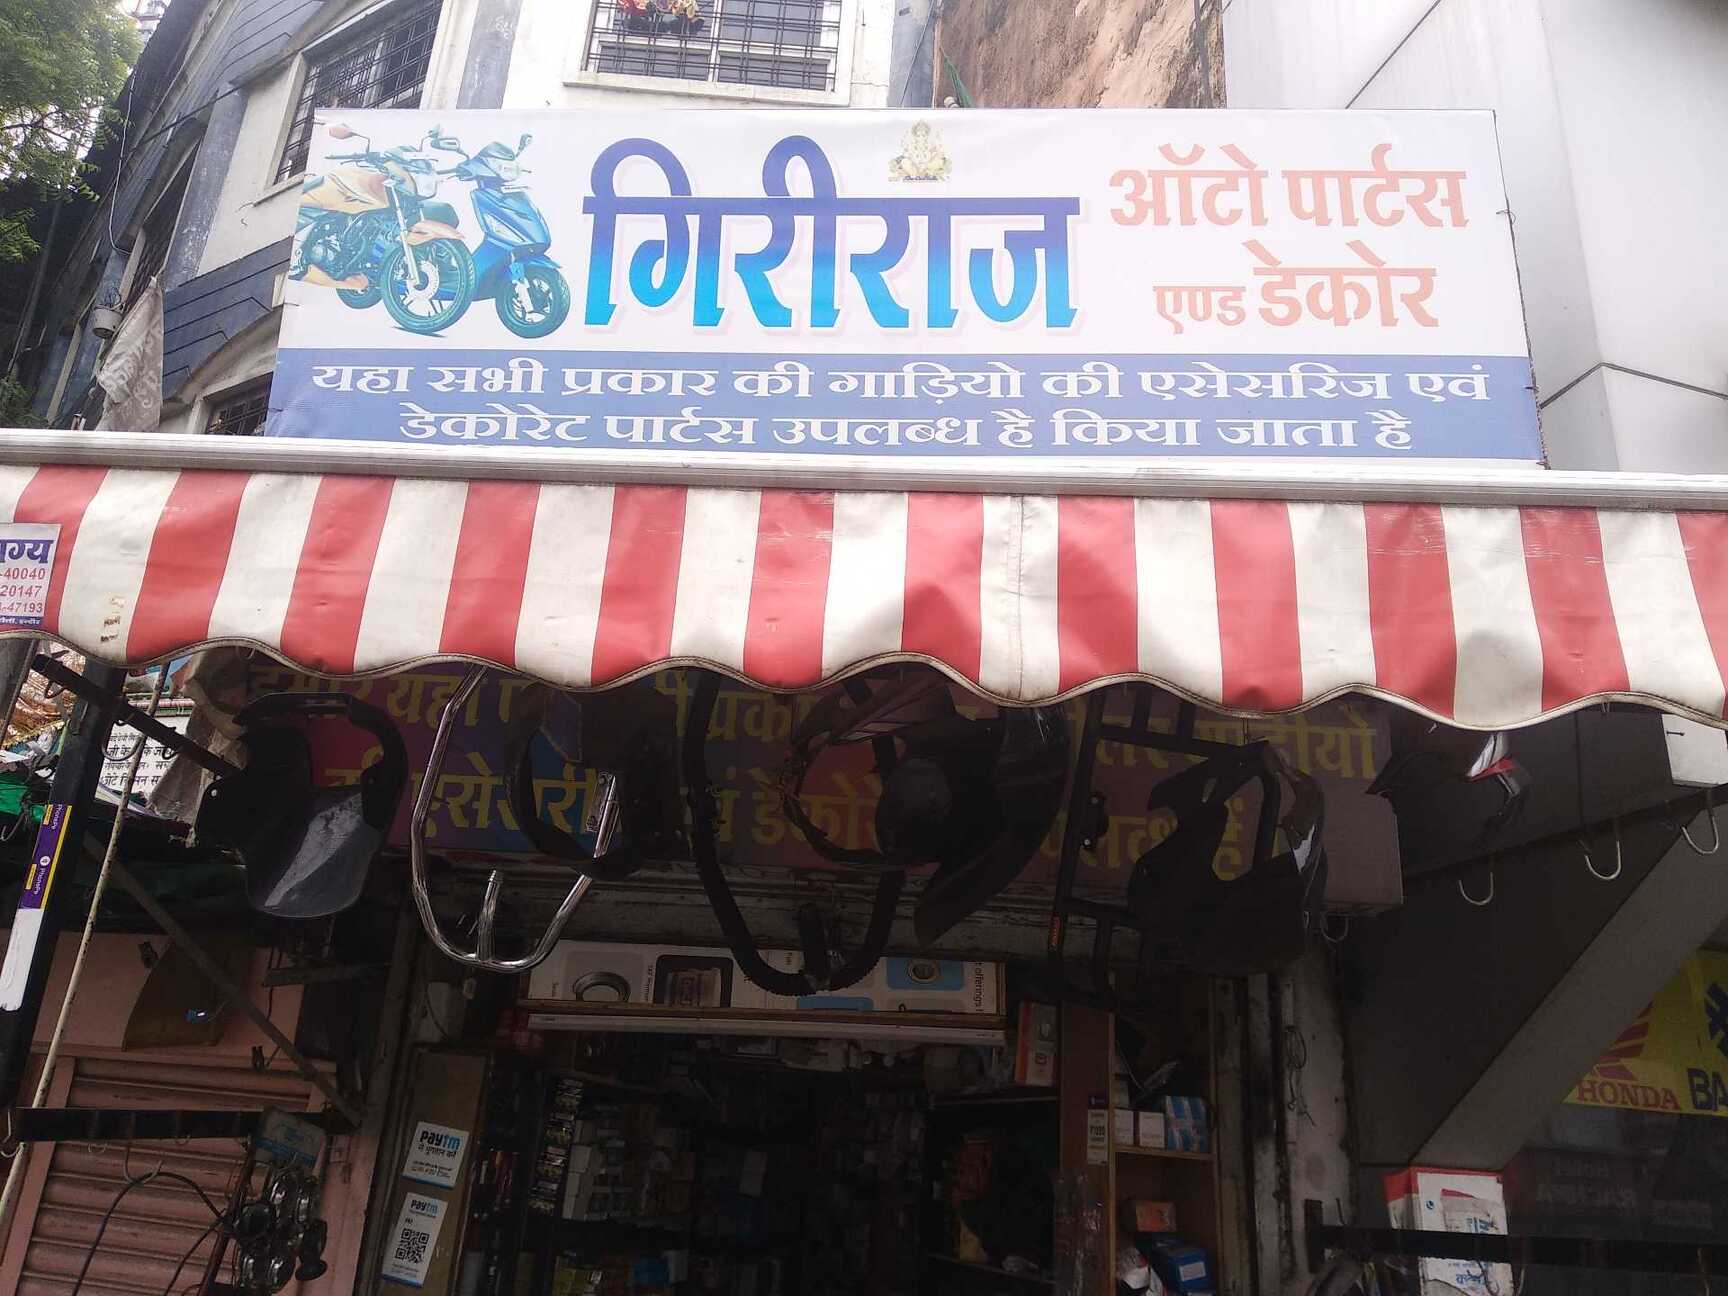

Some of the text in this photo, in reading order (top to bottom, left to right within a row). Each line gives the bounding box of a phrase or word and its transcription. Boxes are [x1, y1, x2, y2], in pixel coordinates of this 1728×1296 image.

[1108, 143, 1469, 227] ऑटो पार्टस
[582, 135, 1080, 328] गिरीराज
[1153, 239, 1439, 334] एण्ड डेकोर
[312, 357, 1492, 405] यहा सभी प्रकार की गाड़ियो की एसेसरिज एवं
[400, 402, 1413, 450] डेकोरेट पार्टस उपलब्ध है किया जाता है
[1577, 1079, 1681, 1111] HONDA
